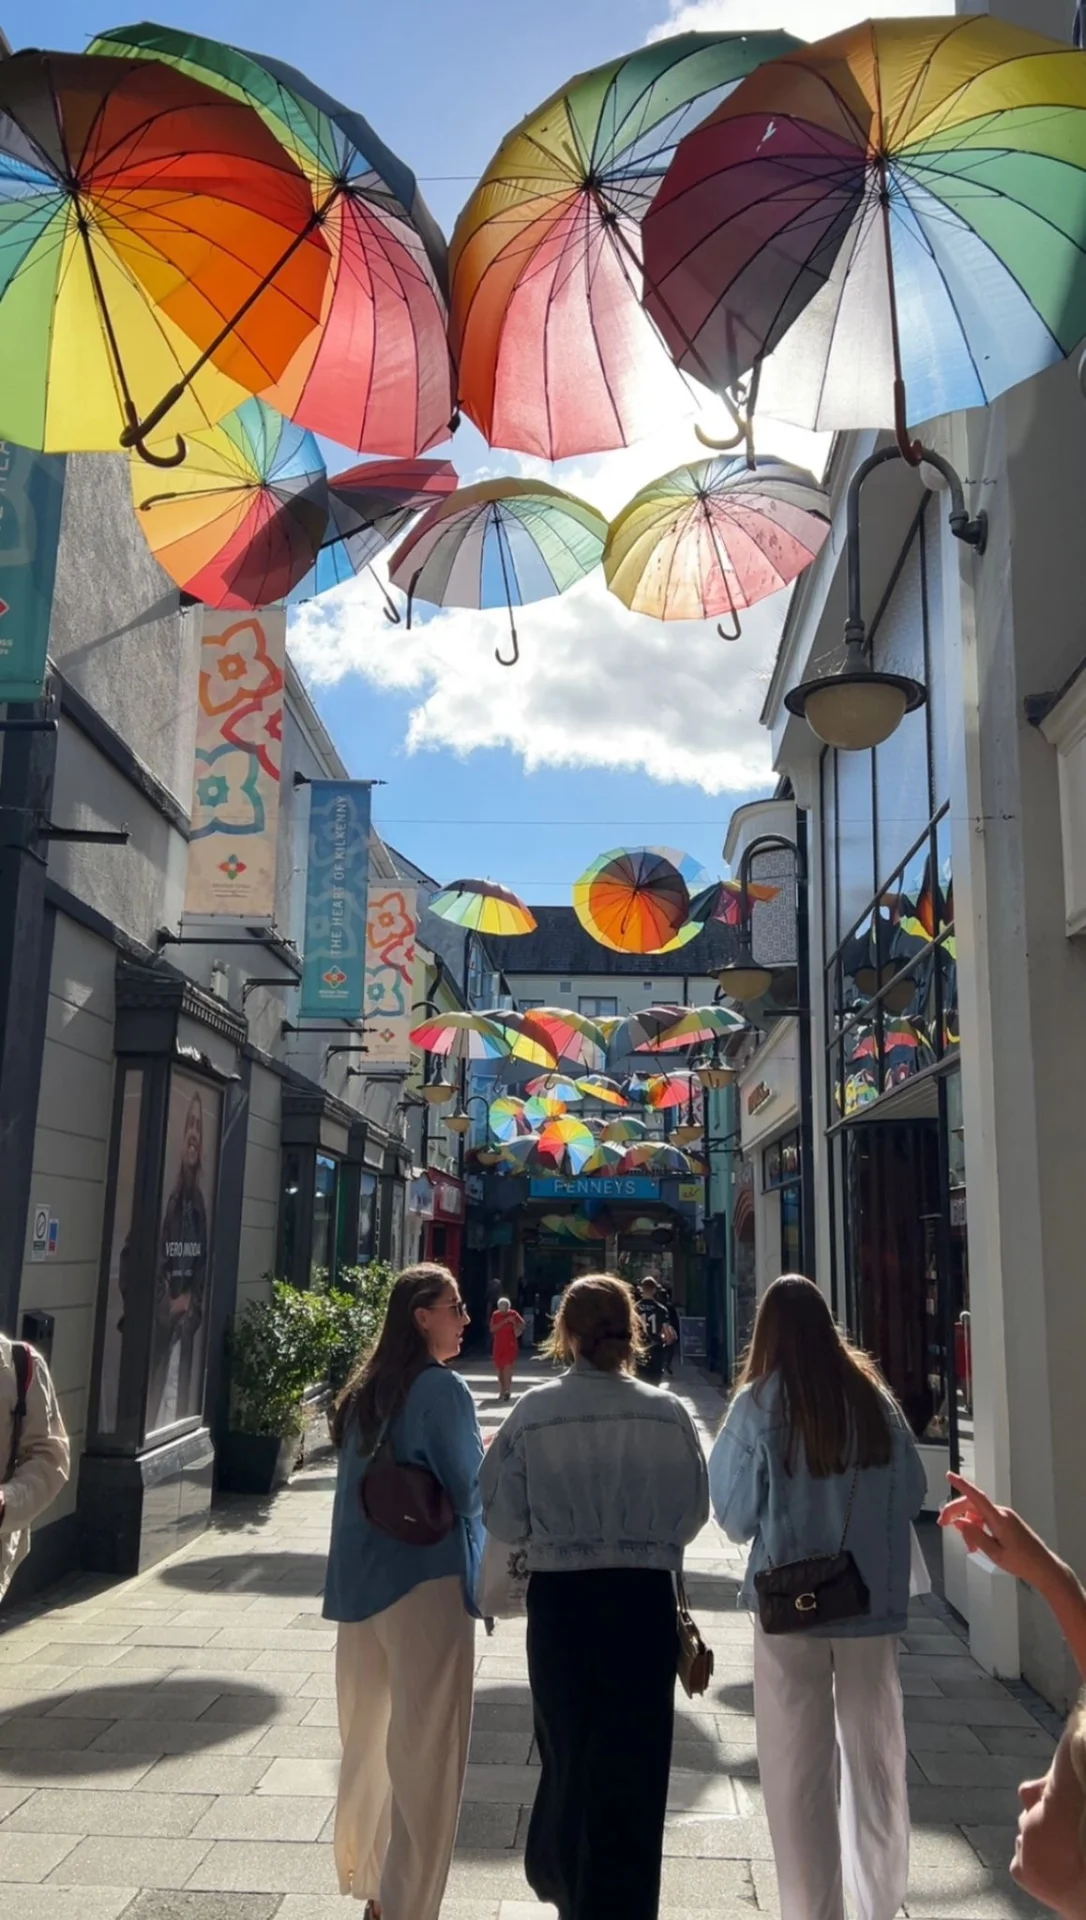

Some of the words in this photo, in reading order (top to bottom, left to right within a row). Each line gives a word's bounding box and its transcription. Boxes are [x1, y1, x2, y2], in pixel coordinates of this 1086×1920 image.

[335, 796, 348, 859] KILKENNY
[333, 863, 345, 879] OF
[332, 887, 345, 924] HEART
[331, 930, 342, 955] THE
[554, 1179, 635, 1194] PENNEYS
[165, 1241, 183, 1257] VERO
[183, 1241, 201, 1257] MODA
